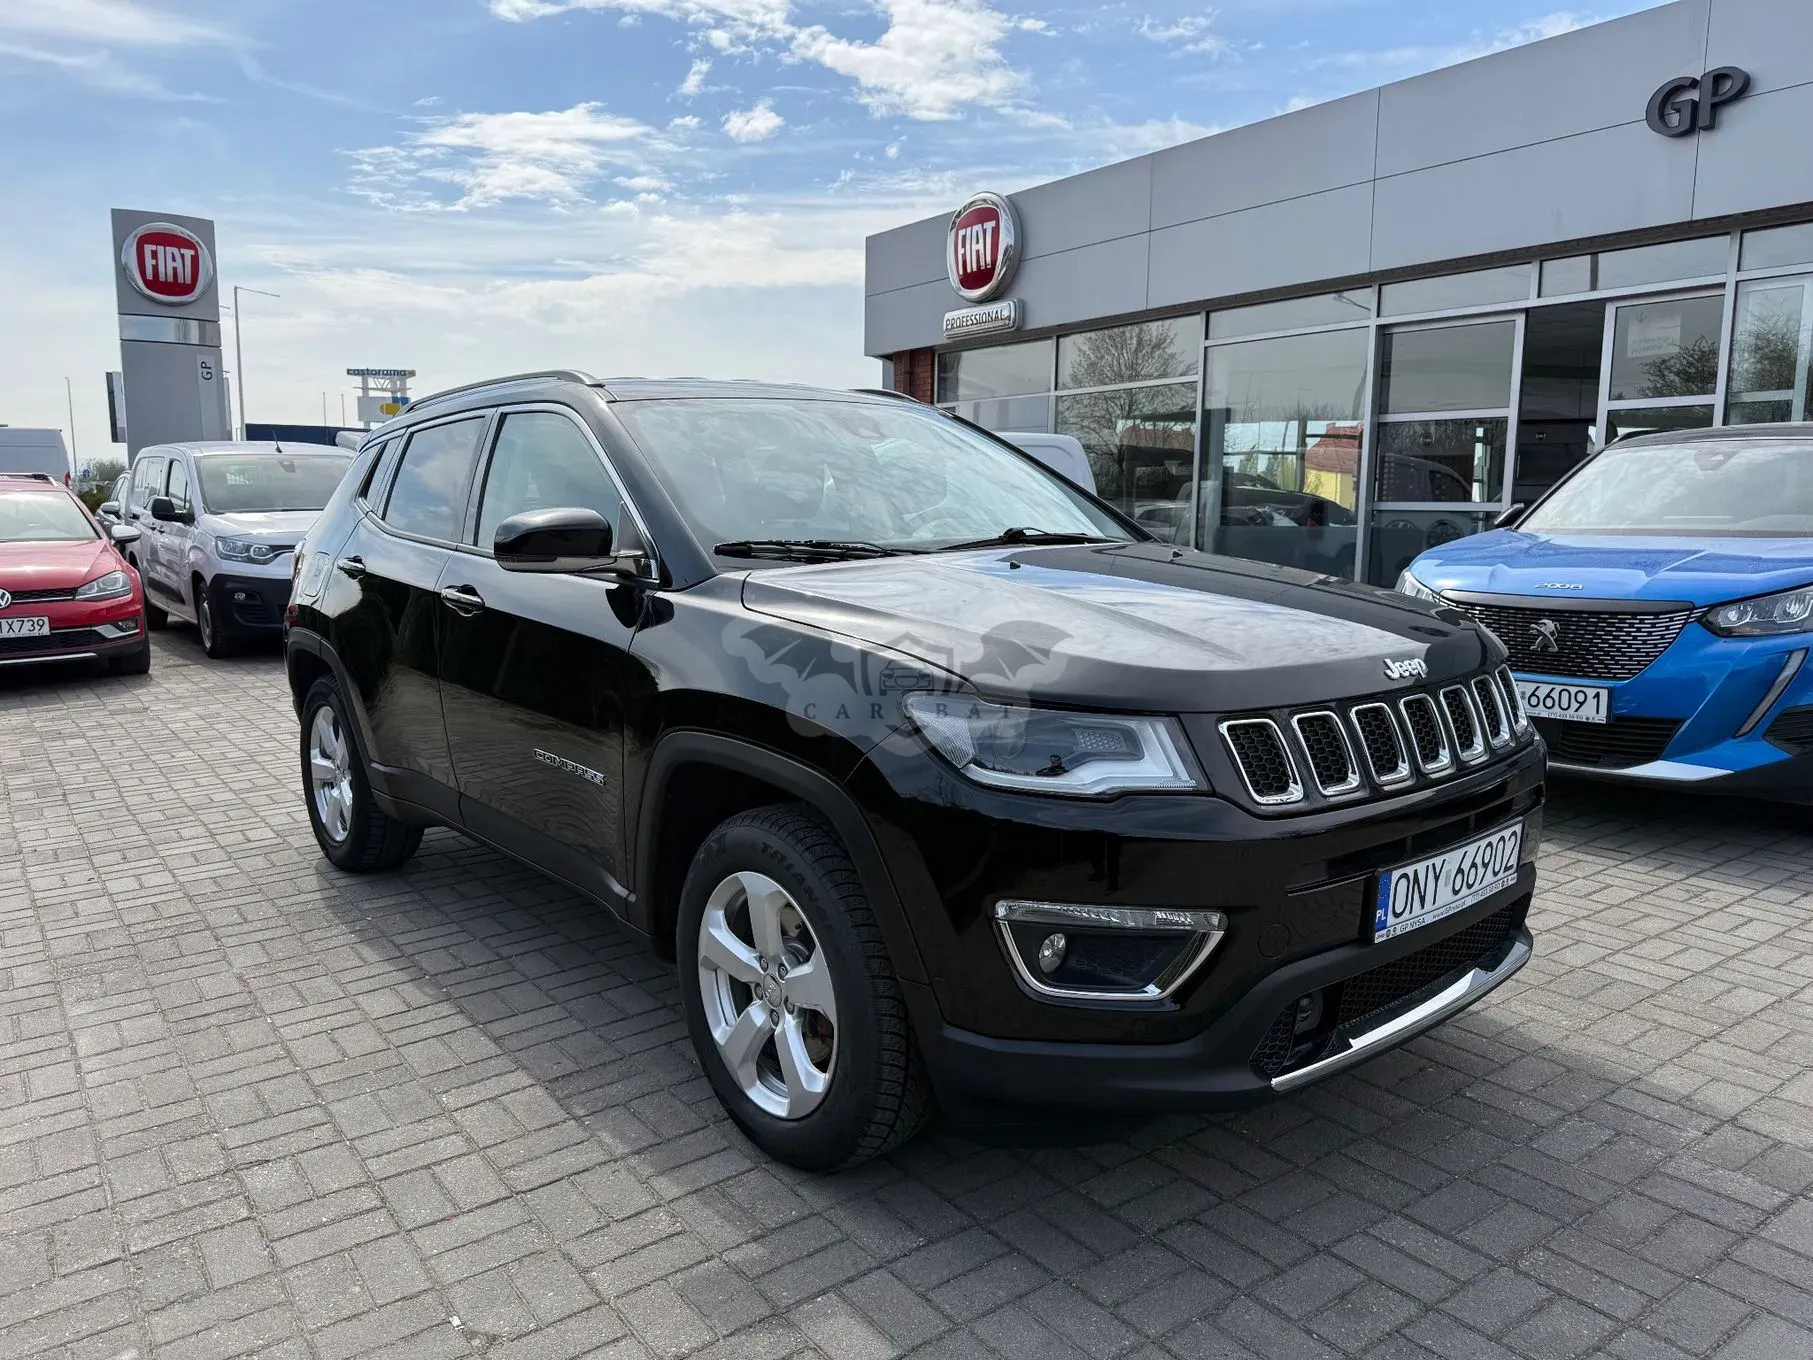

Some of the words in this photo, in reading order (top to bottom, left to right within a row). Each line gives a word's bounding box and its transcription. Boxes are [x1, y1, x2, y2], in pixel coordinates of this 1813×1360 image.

[1646, 66, 1751, 137] GP
[958, 221, 996, 276] FIAT
[144, 244, 195, 284] FIAT
[945, 308, 1005, 330] PROFESSIONAL
[201, 361, 212, 380] GP
[346, 368, 407, 377] castorama
[1384, 658, 1428, 679] Jeep
[1528, 686, 1601, 715] 66091
[1392, 859, 1446, 919] ONY
[1452, 830, 1518, 896] 66902
[1376, 908, 1386, 922] PL
